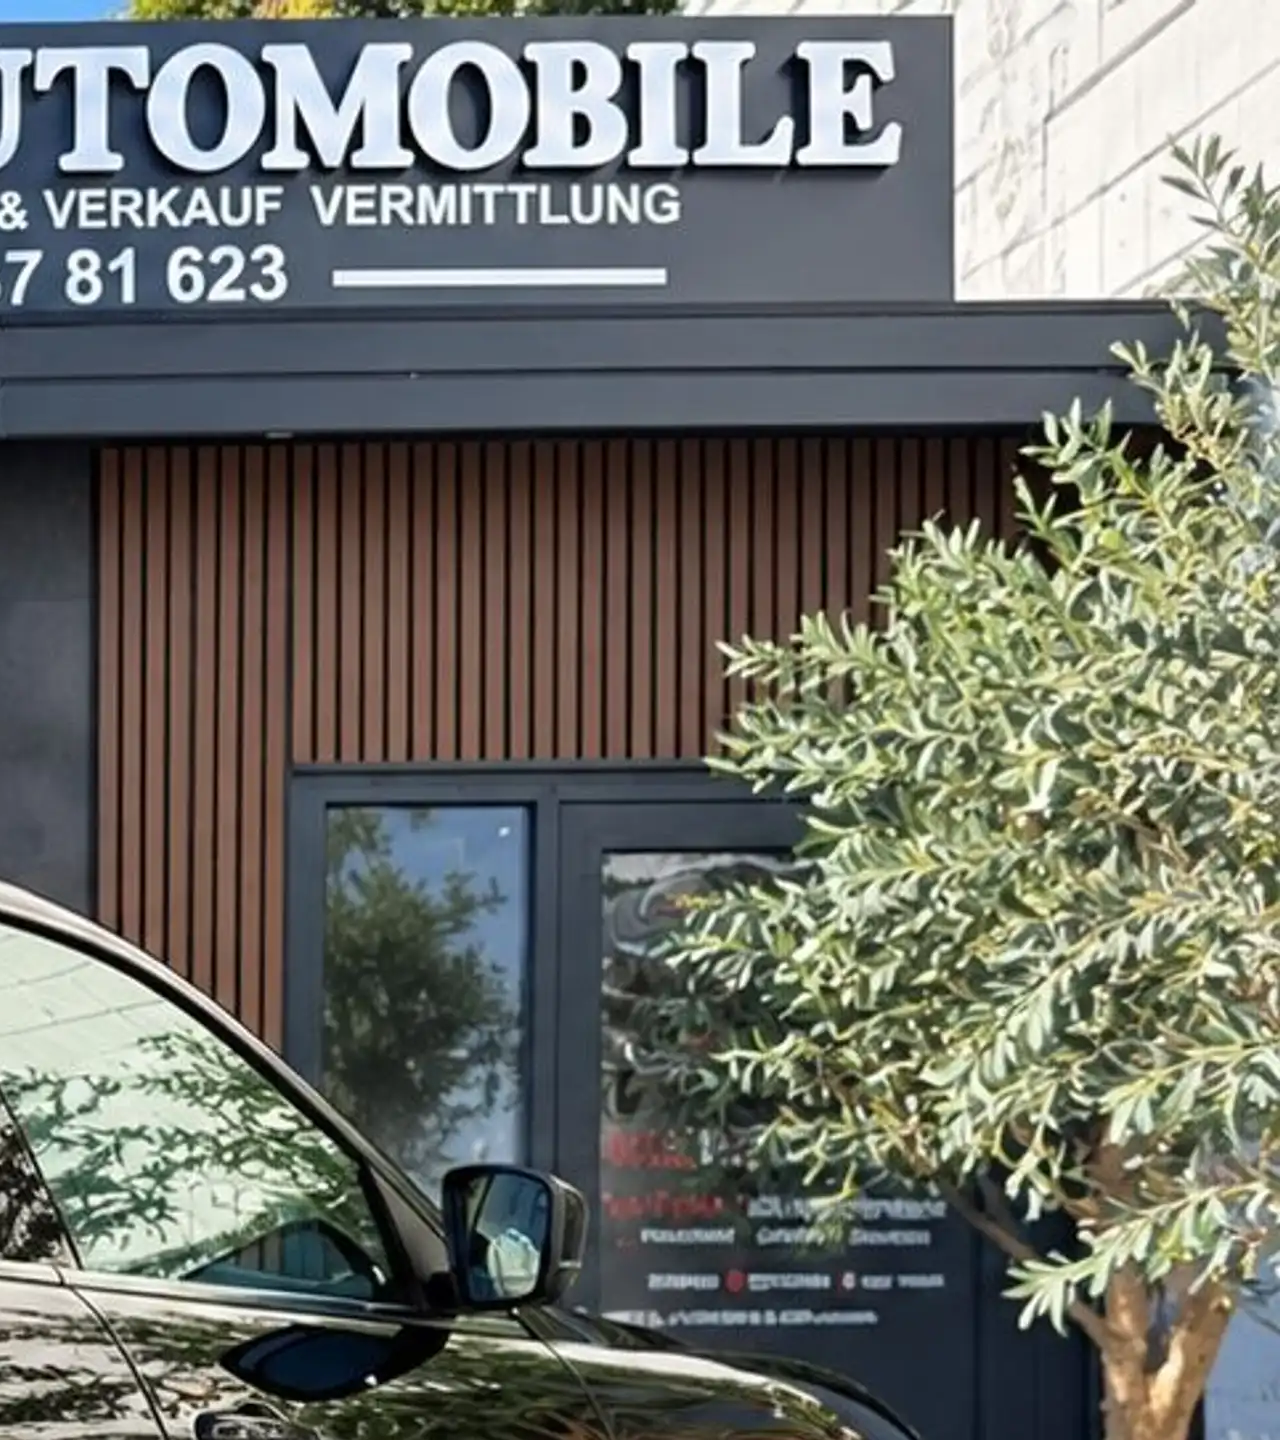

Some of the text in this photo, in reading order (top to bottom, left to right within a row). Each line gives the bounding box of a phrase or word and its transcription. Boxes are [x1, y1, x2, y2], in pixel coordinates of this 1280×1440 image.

[43, 185, 284, 229] VERKAUF
[310, 183, 681, 227] VERMITTLUNG
[65, 247, 135, 305] 81
[167, 244, 288, 303] 623
